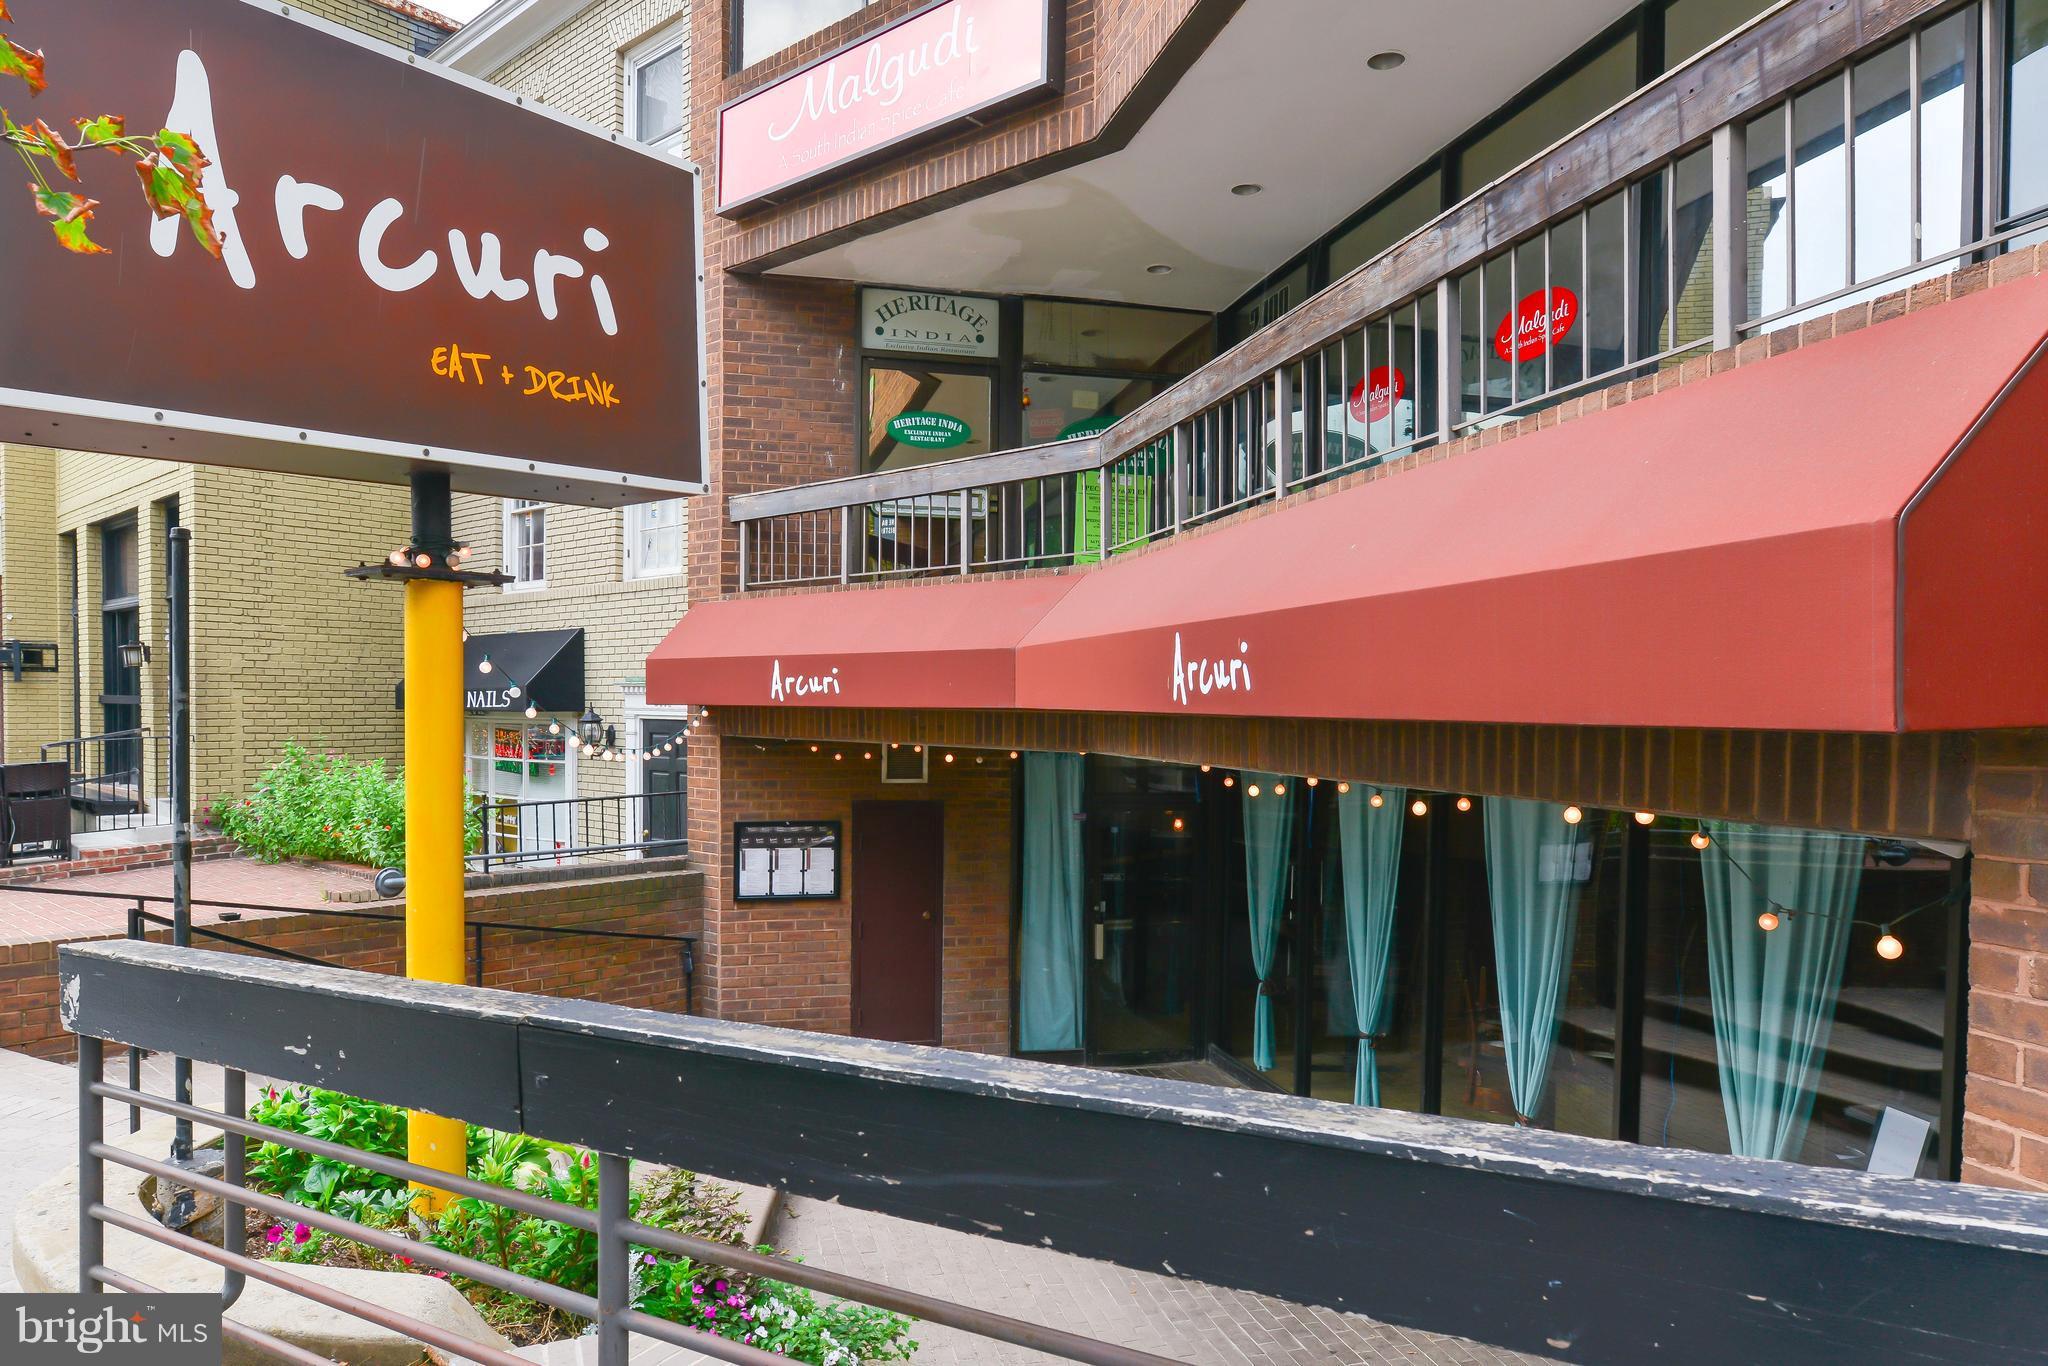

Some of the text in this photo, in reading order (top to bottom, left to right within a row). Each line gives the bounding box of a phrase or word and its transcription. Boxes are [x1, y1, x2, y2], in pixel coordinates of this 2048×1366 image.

[767, 4, 979, 140] Malgudi
[150, 49, 618, 336] Arcuri
[874, 294, 988, 332] HERITAGE
[891, 328, 971, 342] INDIA
[431, 344, 491, 385] EAT
[524, 365, 620, 408] DRINK
[893, 416, 963, 433] HERITAGE INDIA
[771, 659, 840, 702] Arcuri
[1173, 632, 1251, 705] Arcuri
[467, 690, 510, 708] NAILS
